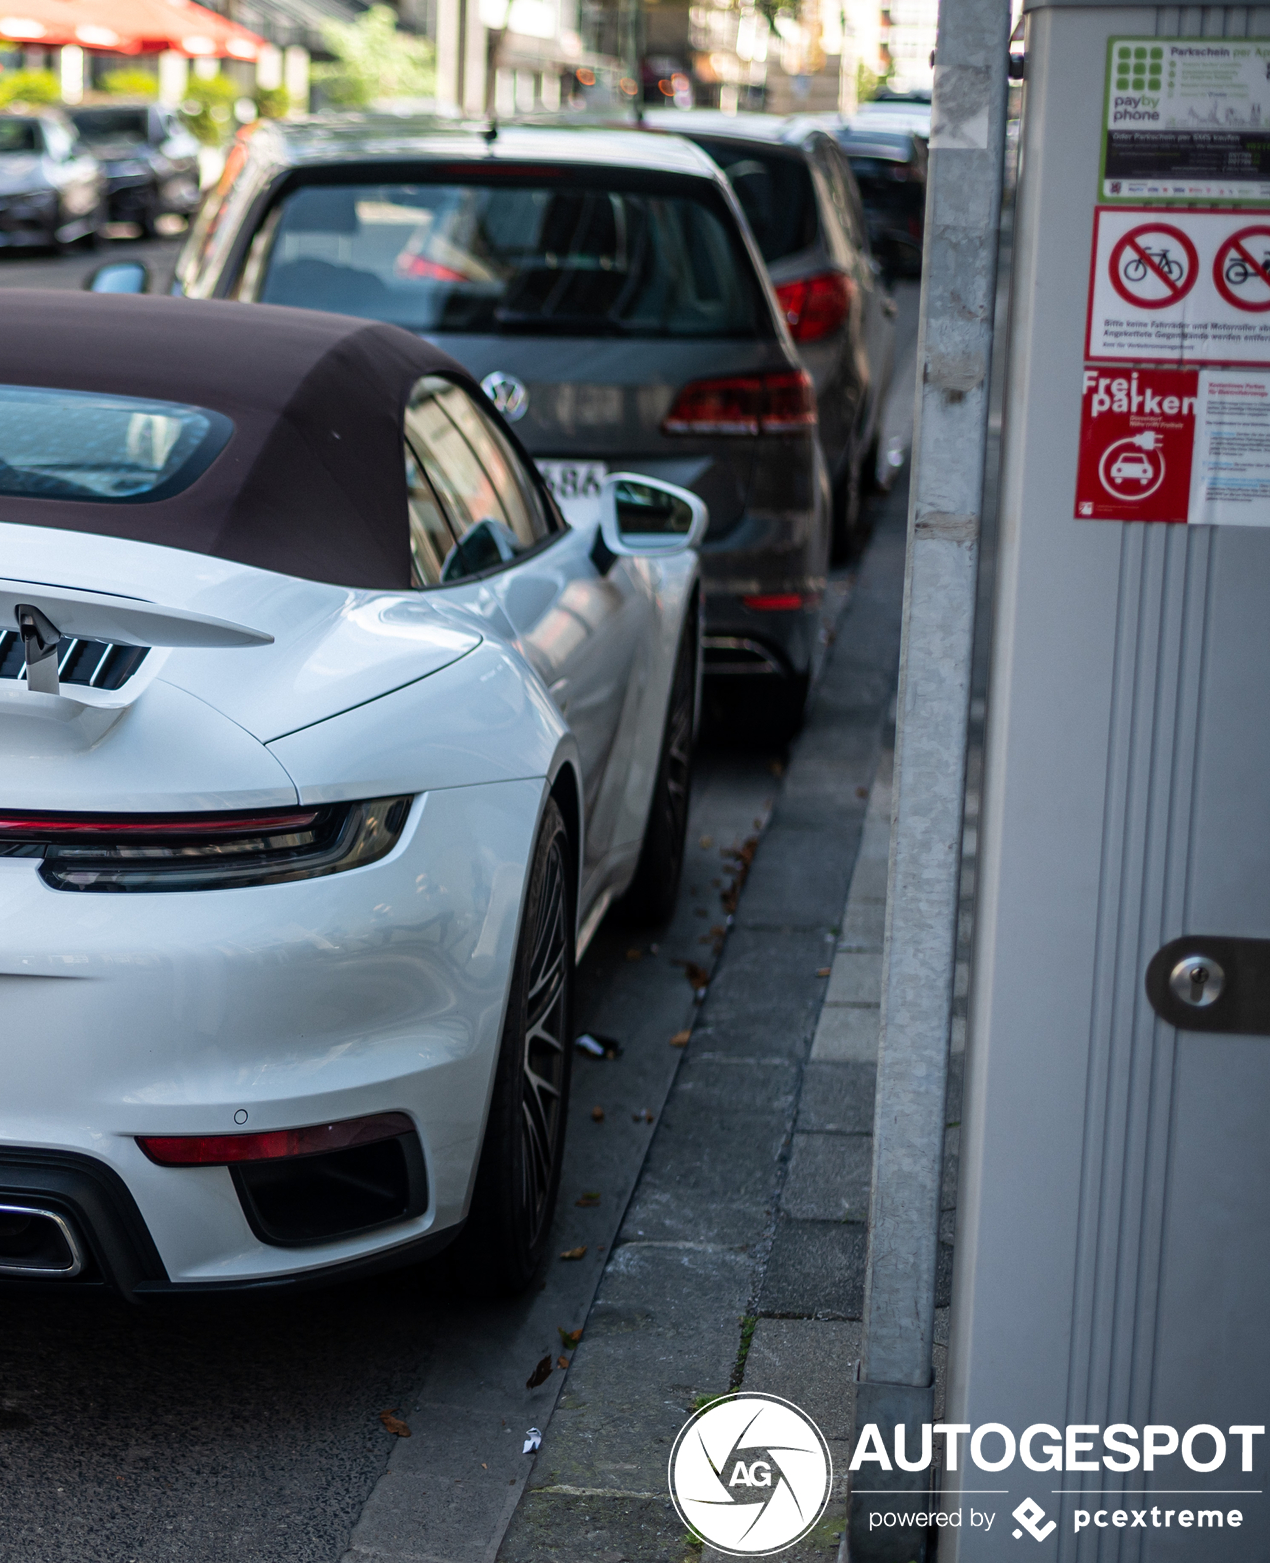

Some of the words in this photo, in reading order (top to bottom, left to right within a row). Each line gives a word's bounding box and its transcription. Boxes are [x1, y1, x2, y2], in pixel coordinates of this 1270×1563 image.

[1171, 46, 1230, 56] Parkschein
[1113, 108, 1160, 123] phone
[1103, 318, 1124, 328] Bitte
[1126, 319, 1148, 329] keine
[1192, 322, 1208, 331] und
[1210, 322, 1256, 332] Motorroller
[1103, 330, 1152, 340] Angekettete
[1211, 333, 1241, 342] werden
[1082, 371, 1139, 395] Frei
[1091, 388, 1197, 417] parken
